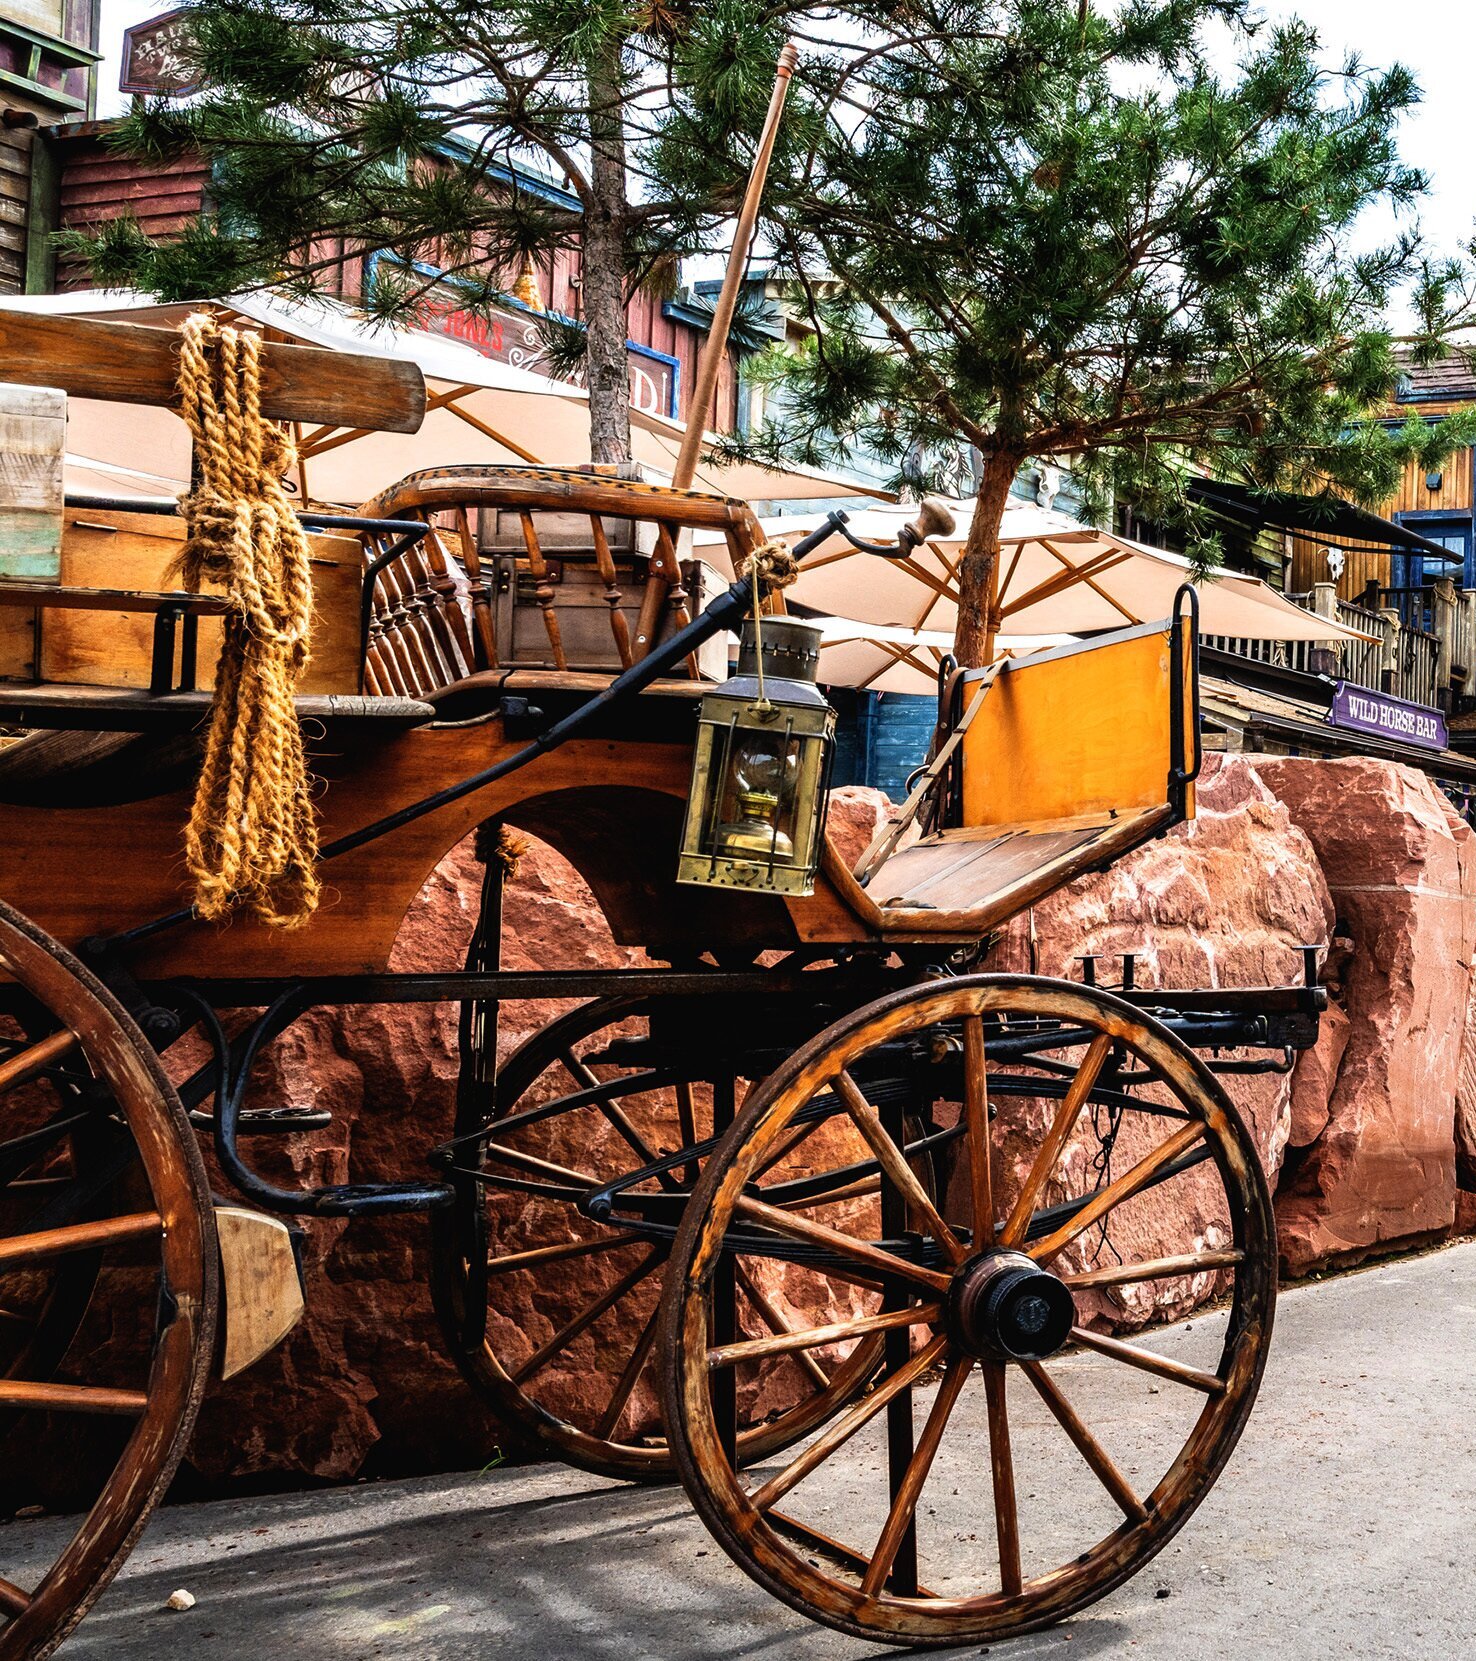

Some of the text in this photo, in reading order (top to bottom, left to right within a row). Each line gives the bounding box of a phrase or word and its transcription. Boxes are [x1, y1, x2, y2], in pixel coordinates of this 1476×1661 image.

[1348, 695, 1437, 740] WILD HORSE BAR
